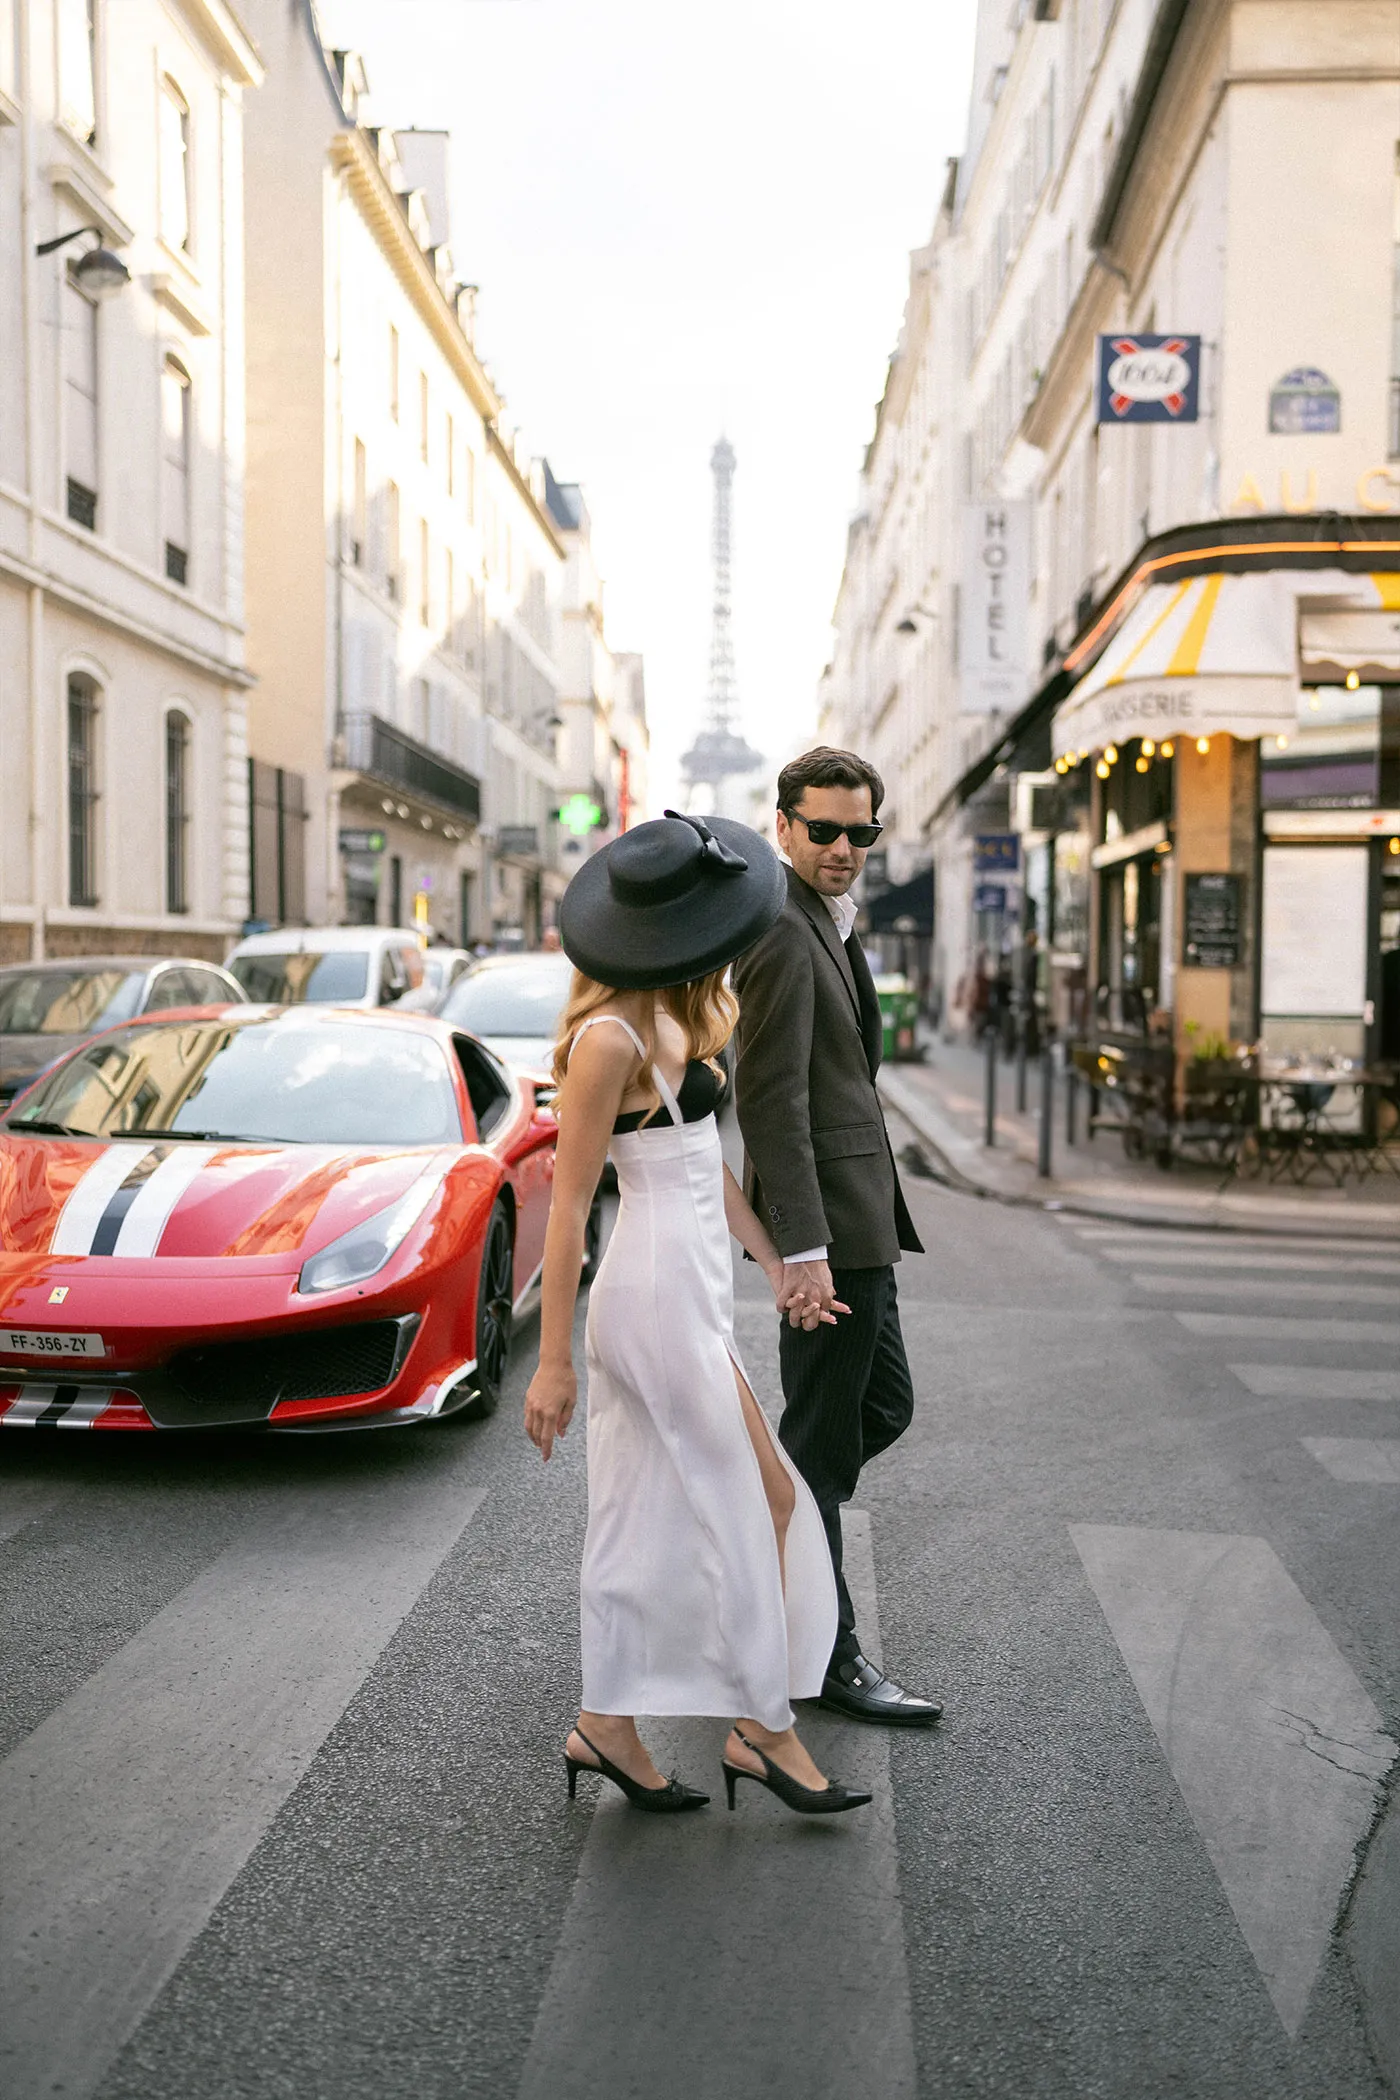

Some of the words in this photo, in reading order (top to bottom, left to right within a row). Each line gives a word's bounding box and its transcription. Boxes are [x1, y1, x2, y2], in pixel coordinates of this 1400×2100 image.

[1229, 469, 1318, 513] AU
[983, 511, 1008, 663] HOTEL
[10, 1334, 87, 1352] FF-356-ZY
